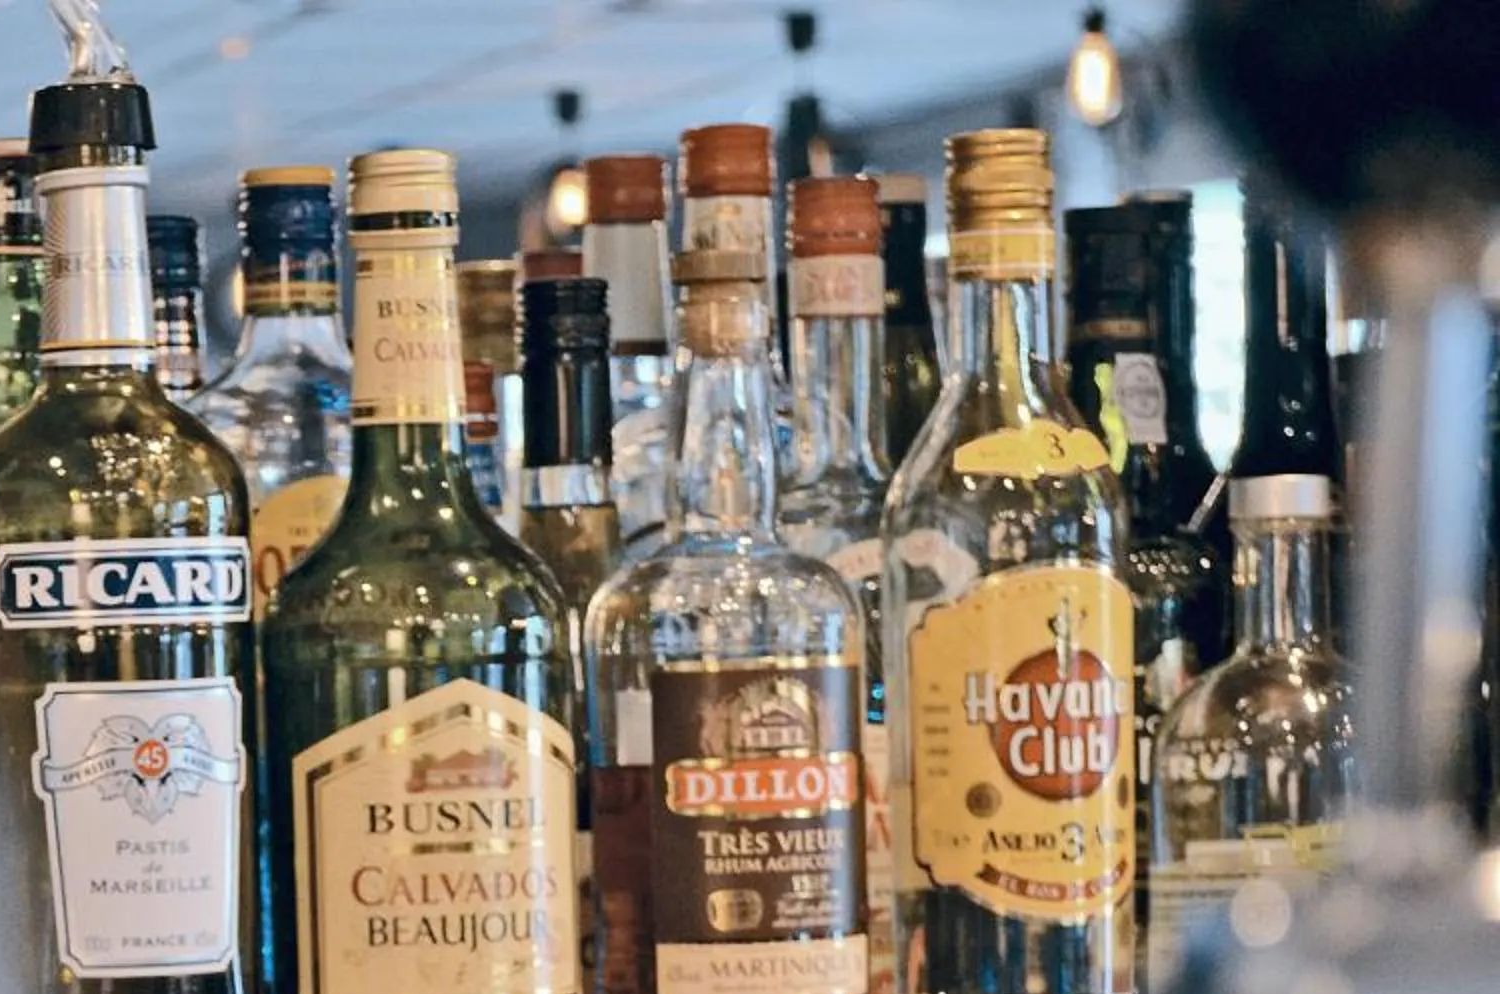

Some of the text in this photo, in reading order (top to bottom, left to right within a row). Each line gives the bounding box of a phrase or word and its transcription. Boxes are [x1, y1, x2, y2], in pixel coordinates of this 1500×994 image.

[11, 559, 244, 610] RICARD
[137, 742, 165, 769] 45
[1009, 720, 1110, 778] Club
[685, 764, 850, 805] DILLON
[366, 797, 547, 835] BUSNEL
[115, 839, 191, 856] PASTIS
[697, 826, 771, 857] TRÈS
[704, 856, 763, 876] RHUM
[89, 876, 211, 895] MARSEILLE
[351, 865, 558, 907] CALVADOS
[121, 935, 188, 949] FRANCE
